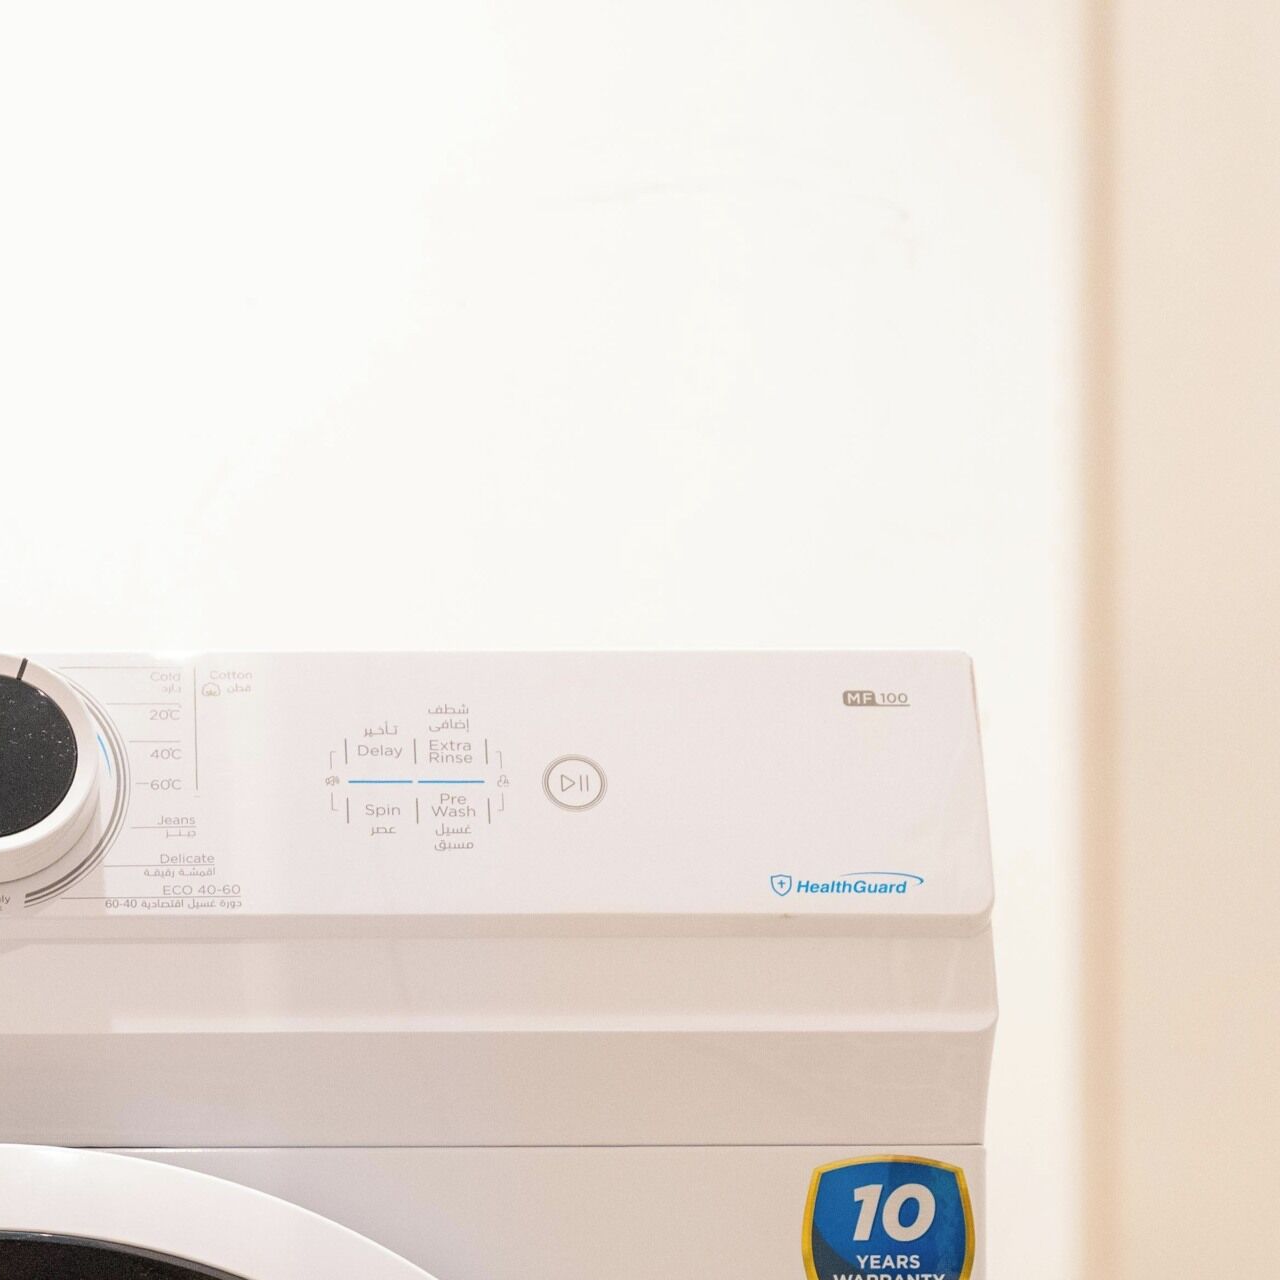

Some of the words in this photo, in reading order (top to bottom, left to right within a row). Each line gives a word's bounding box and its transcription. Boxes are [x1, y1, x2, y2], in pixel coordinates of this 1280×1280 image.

[150, 671, 181, 682] Cold
[209, 670, 253, 680] Cotton
[846, 692, 874, 705] MF
[880, 692, 909, 704] 100
[427, 703, 470, 715] شطف
[357, 744, 403, 759] Delay
[429, 739, 472, 751] Extra
[429, 751, 473, 764] Rinse
[439, 792, 467, 805] Pre
[364, 804, 401, 818] Spin
[431, 805, 476, 818] Wash
[157, 815, 196, 825] Jeans
[369, 825, 397, 837] عصر
[435, 823, 472, 837] غسيل
[434, 839, 474, 852] مسبق
[159, 853, 216, 864] Delicate
[162, 884, 193, 896] ECO
[198, 883, 241, 895] 40-60
[796, 880, 908, 894] HealthGuard
[187, 898, 216, 910] غسيل
[853, 1183, 936, 1242] 10
[856, 1255, 921, 1269] YEARS
